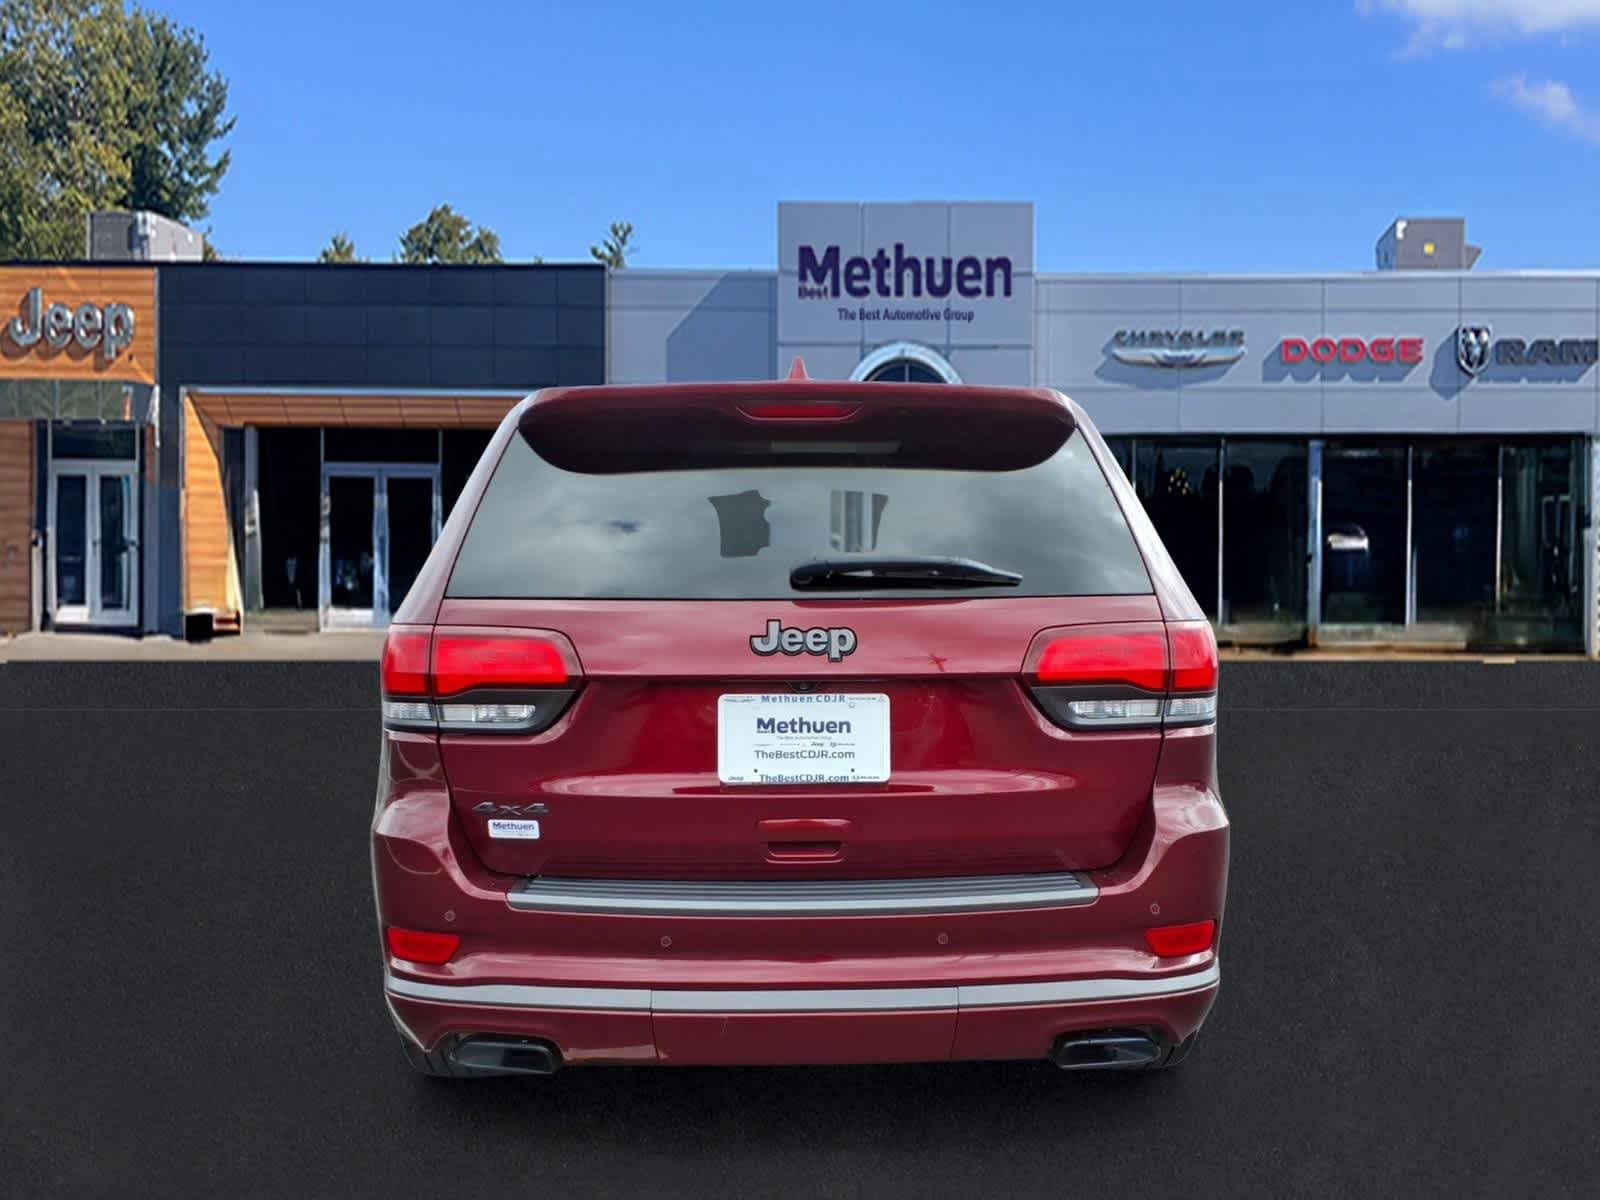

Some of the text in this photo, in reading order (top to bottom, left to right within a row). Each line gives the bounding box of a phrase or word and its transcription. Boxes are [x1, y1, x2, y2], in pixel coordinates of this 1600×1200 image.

[798, 243, 1012, 298] Methuen
[9, 288, 135, 360] Jeep
[838, 308, 975, 324] The Best Automotive Group
[1114, 330, 1244, 348] CHRYSLER
[1282, 338, 1424, 363] DODGE
[1495, 339, 1598, 365] RAM
[750, 619, 857, 662] Jeep
[761, 695, 813, 704] Methuen
[816, 695, 846, 704] CDJR
[756, 717, 851, 734] Methuen
[755, 750, 856, 760] TheBestCDJR.com
[760, 774, 850, 784] TheBestCDJR.com
[472, 802, 549, 815] 4x4
[493, 822, 535, 831] Methuen
